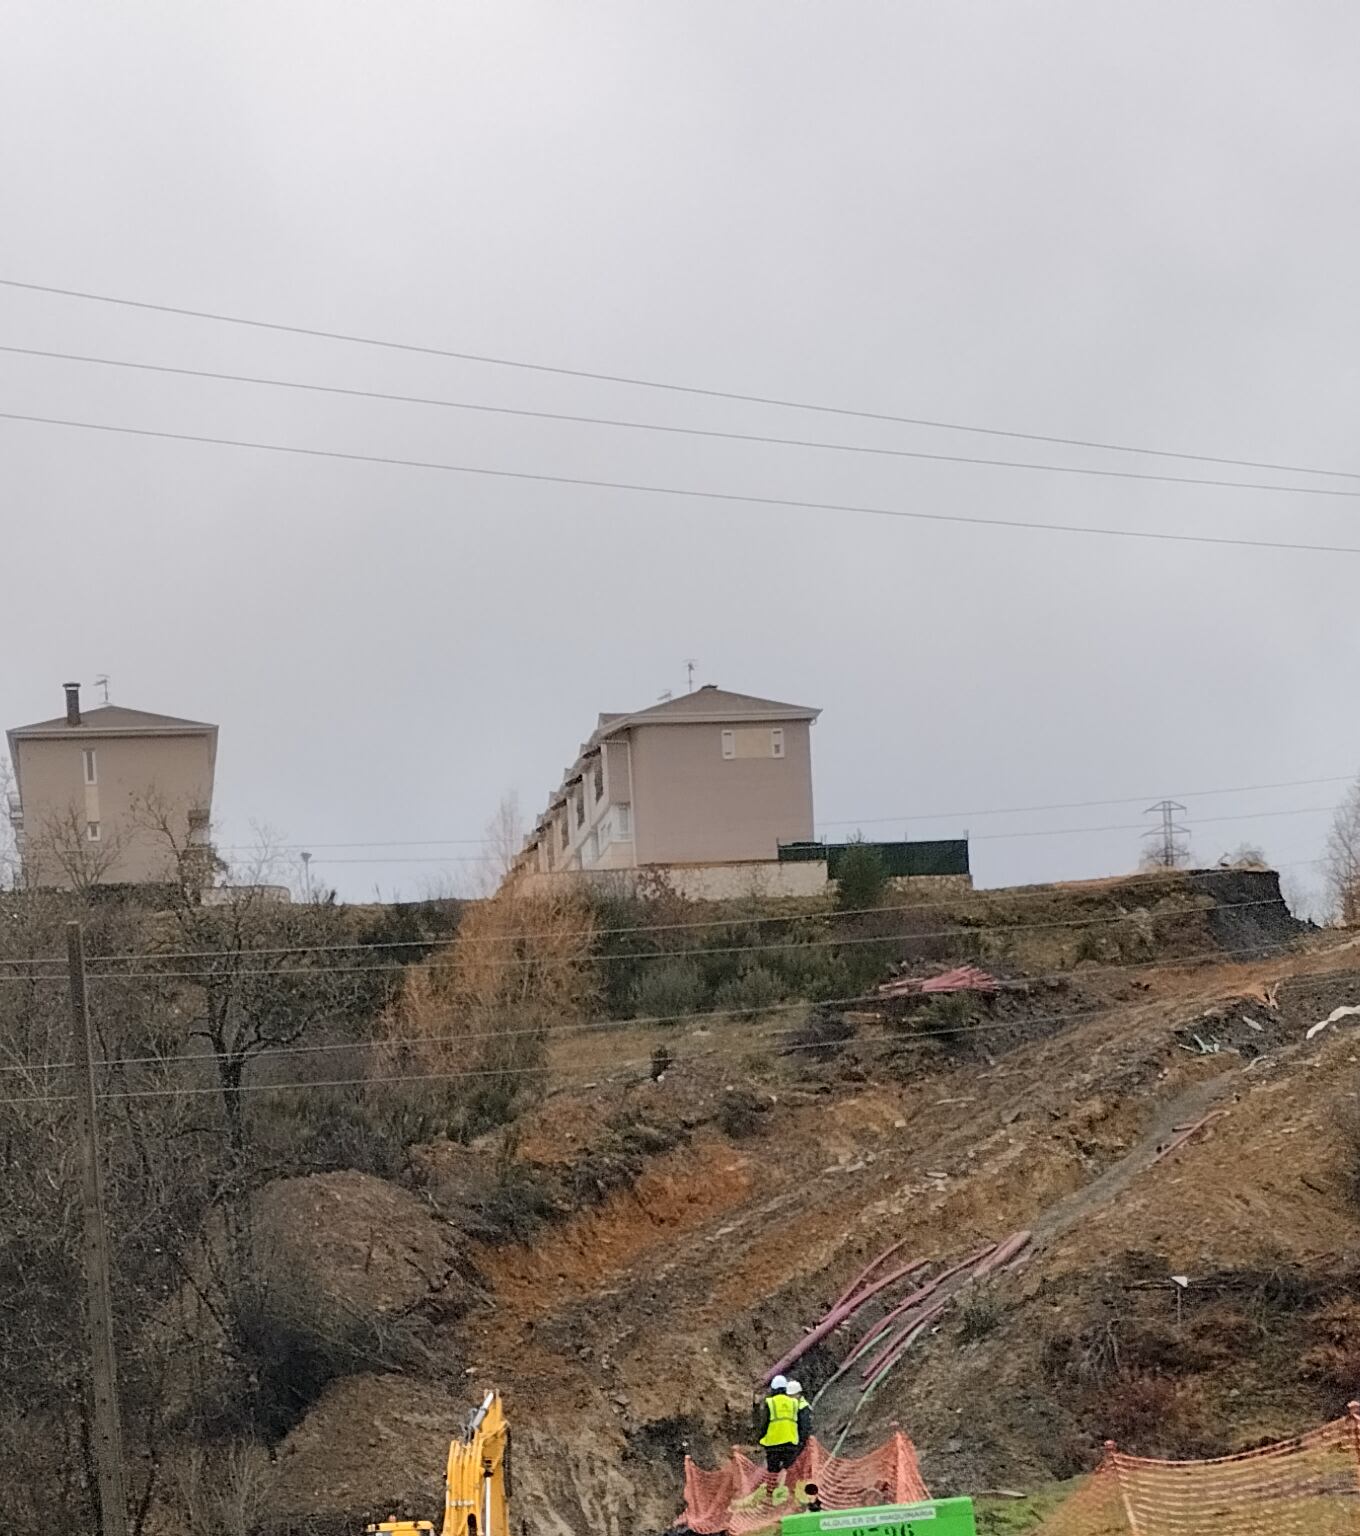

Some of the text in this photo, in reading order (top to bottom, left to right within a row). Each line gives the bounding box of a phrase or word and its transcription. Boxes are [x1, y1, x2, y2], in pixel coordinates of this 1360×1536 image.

[822, 1509, 933, 1528] ALQUILER DE MAQUINARIA
